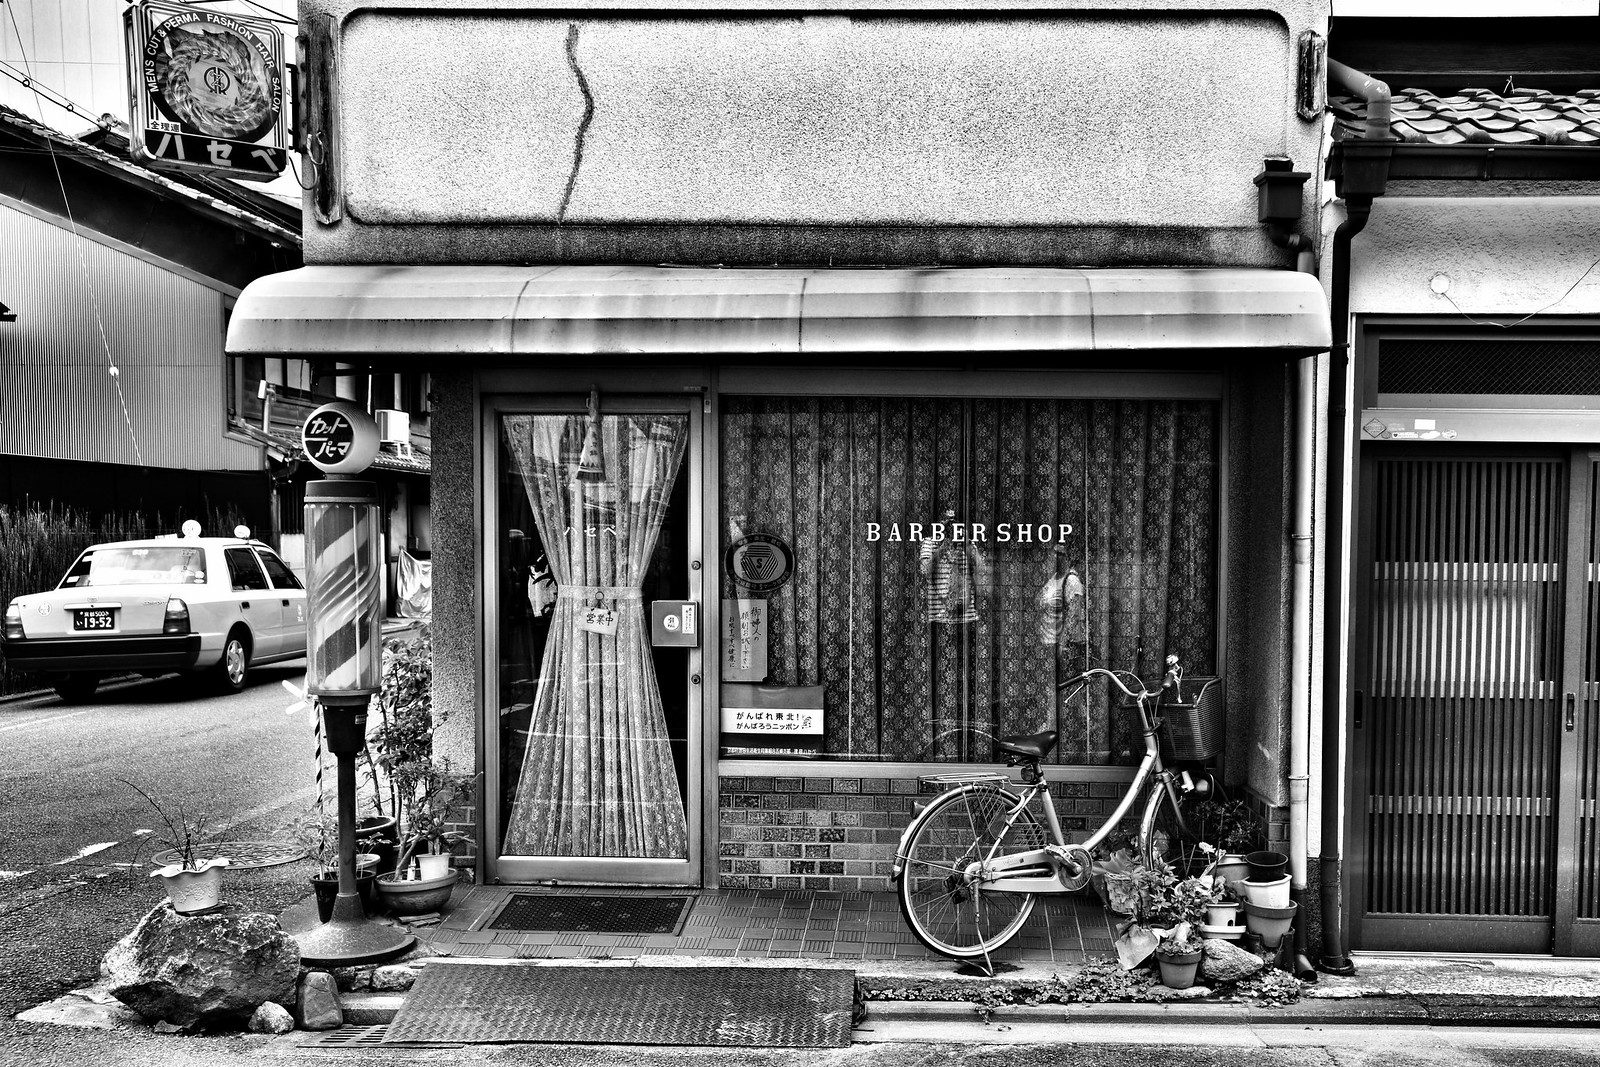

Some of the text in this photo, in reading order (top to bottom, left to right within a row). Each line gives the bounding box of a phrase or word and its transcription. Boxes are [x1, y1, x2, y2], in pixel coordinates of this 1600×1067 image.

[144, 13, 282, 113] MEN'S CUT & PERMA FASHION HAIR SALON
[155, 133, 279, 172] ハセベ
[310, 417, 348, 434] カット
[314, 440, 351, 458] パーマ
[563, 525, 617, 537] ハセベ
[866, 522, 1073, 543] BARBER SHOP
[586, 612, 614, 626] 営業中
